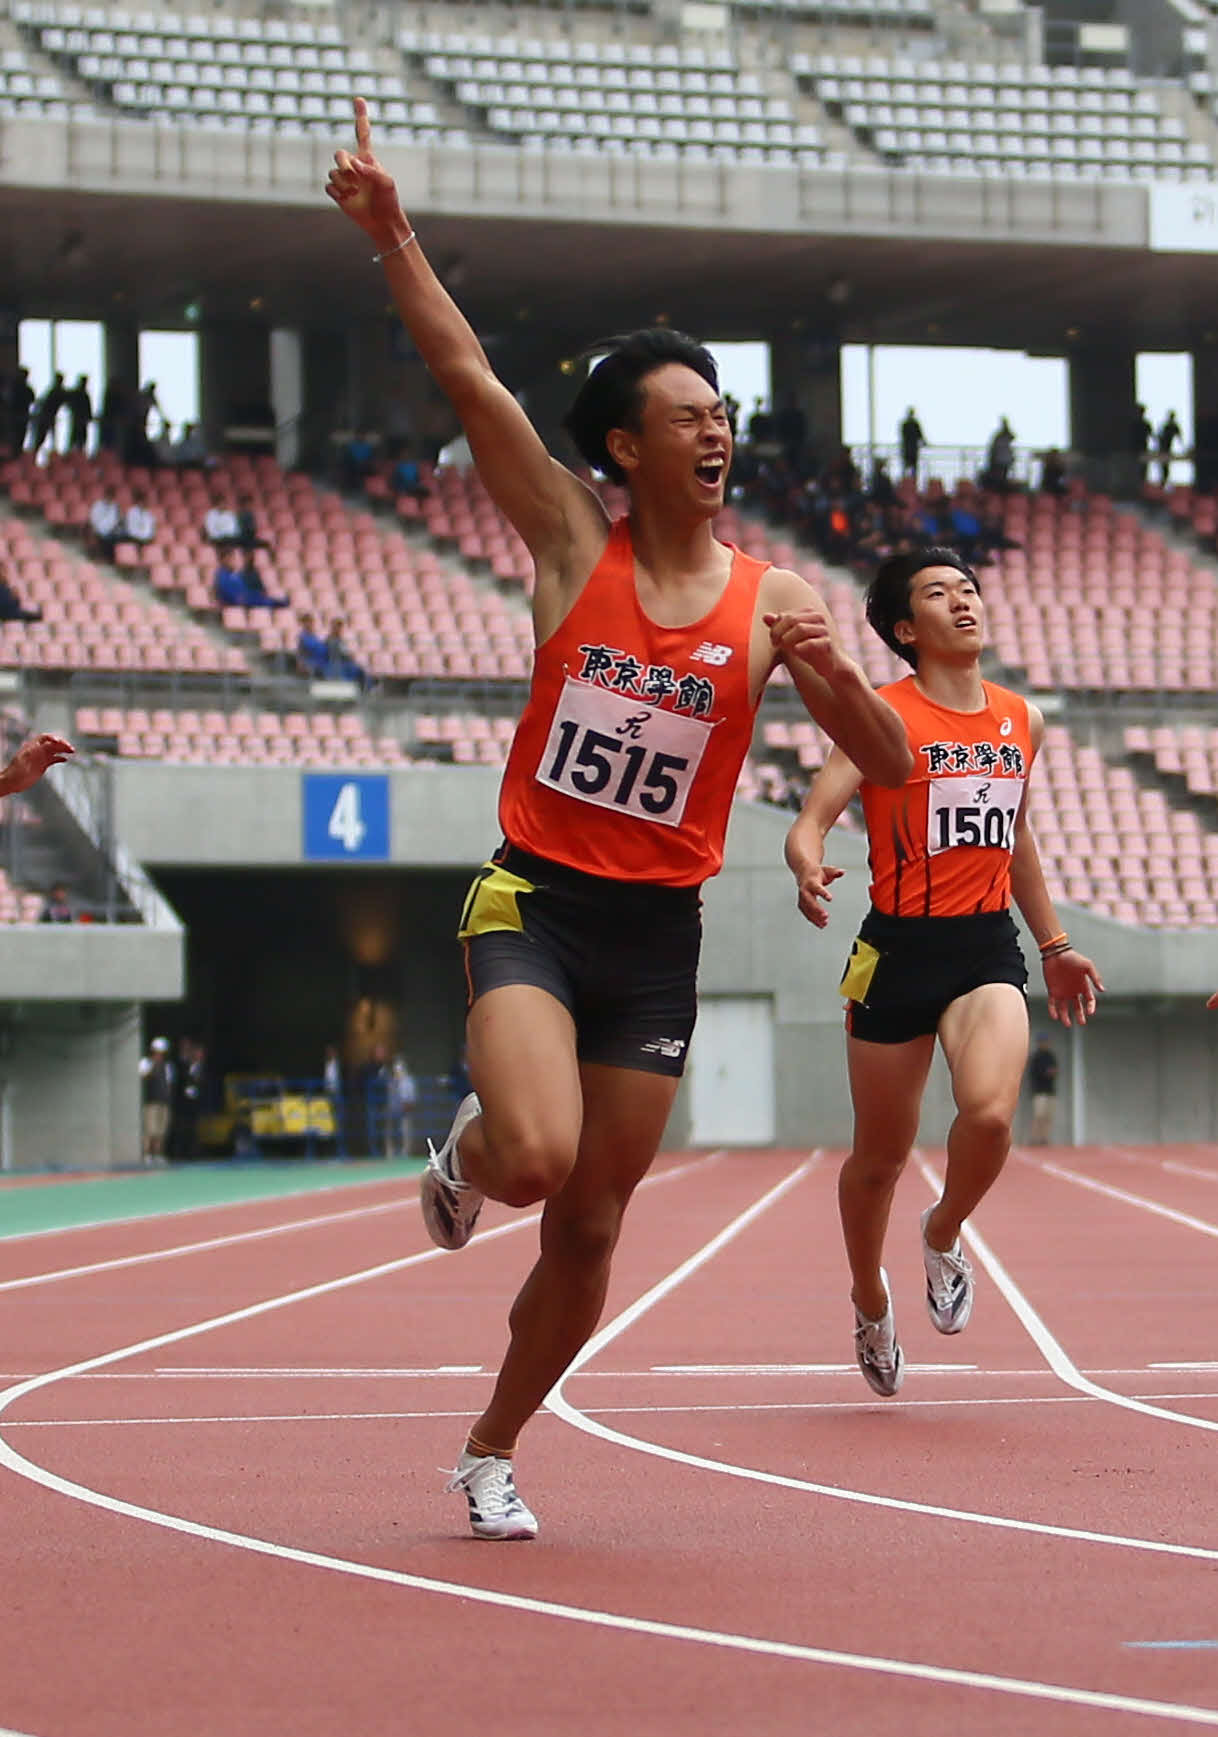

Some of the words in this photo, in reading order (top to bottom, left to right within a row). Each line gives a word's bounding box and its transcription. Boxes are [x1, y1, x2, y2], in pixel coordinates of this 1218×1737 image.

[549, 720, 689, 814] 1515
[328, 782, 365, 851] 4
[935, 807, 1016, 850] 1501
